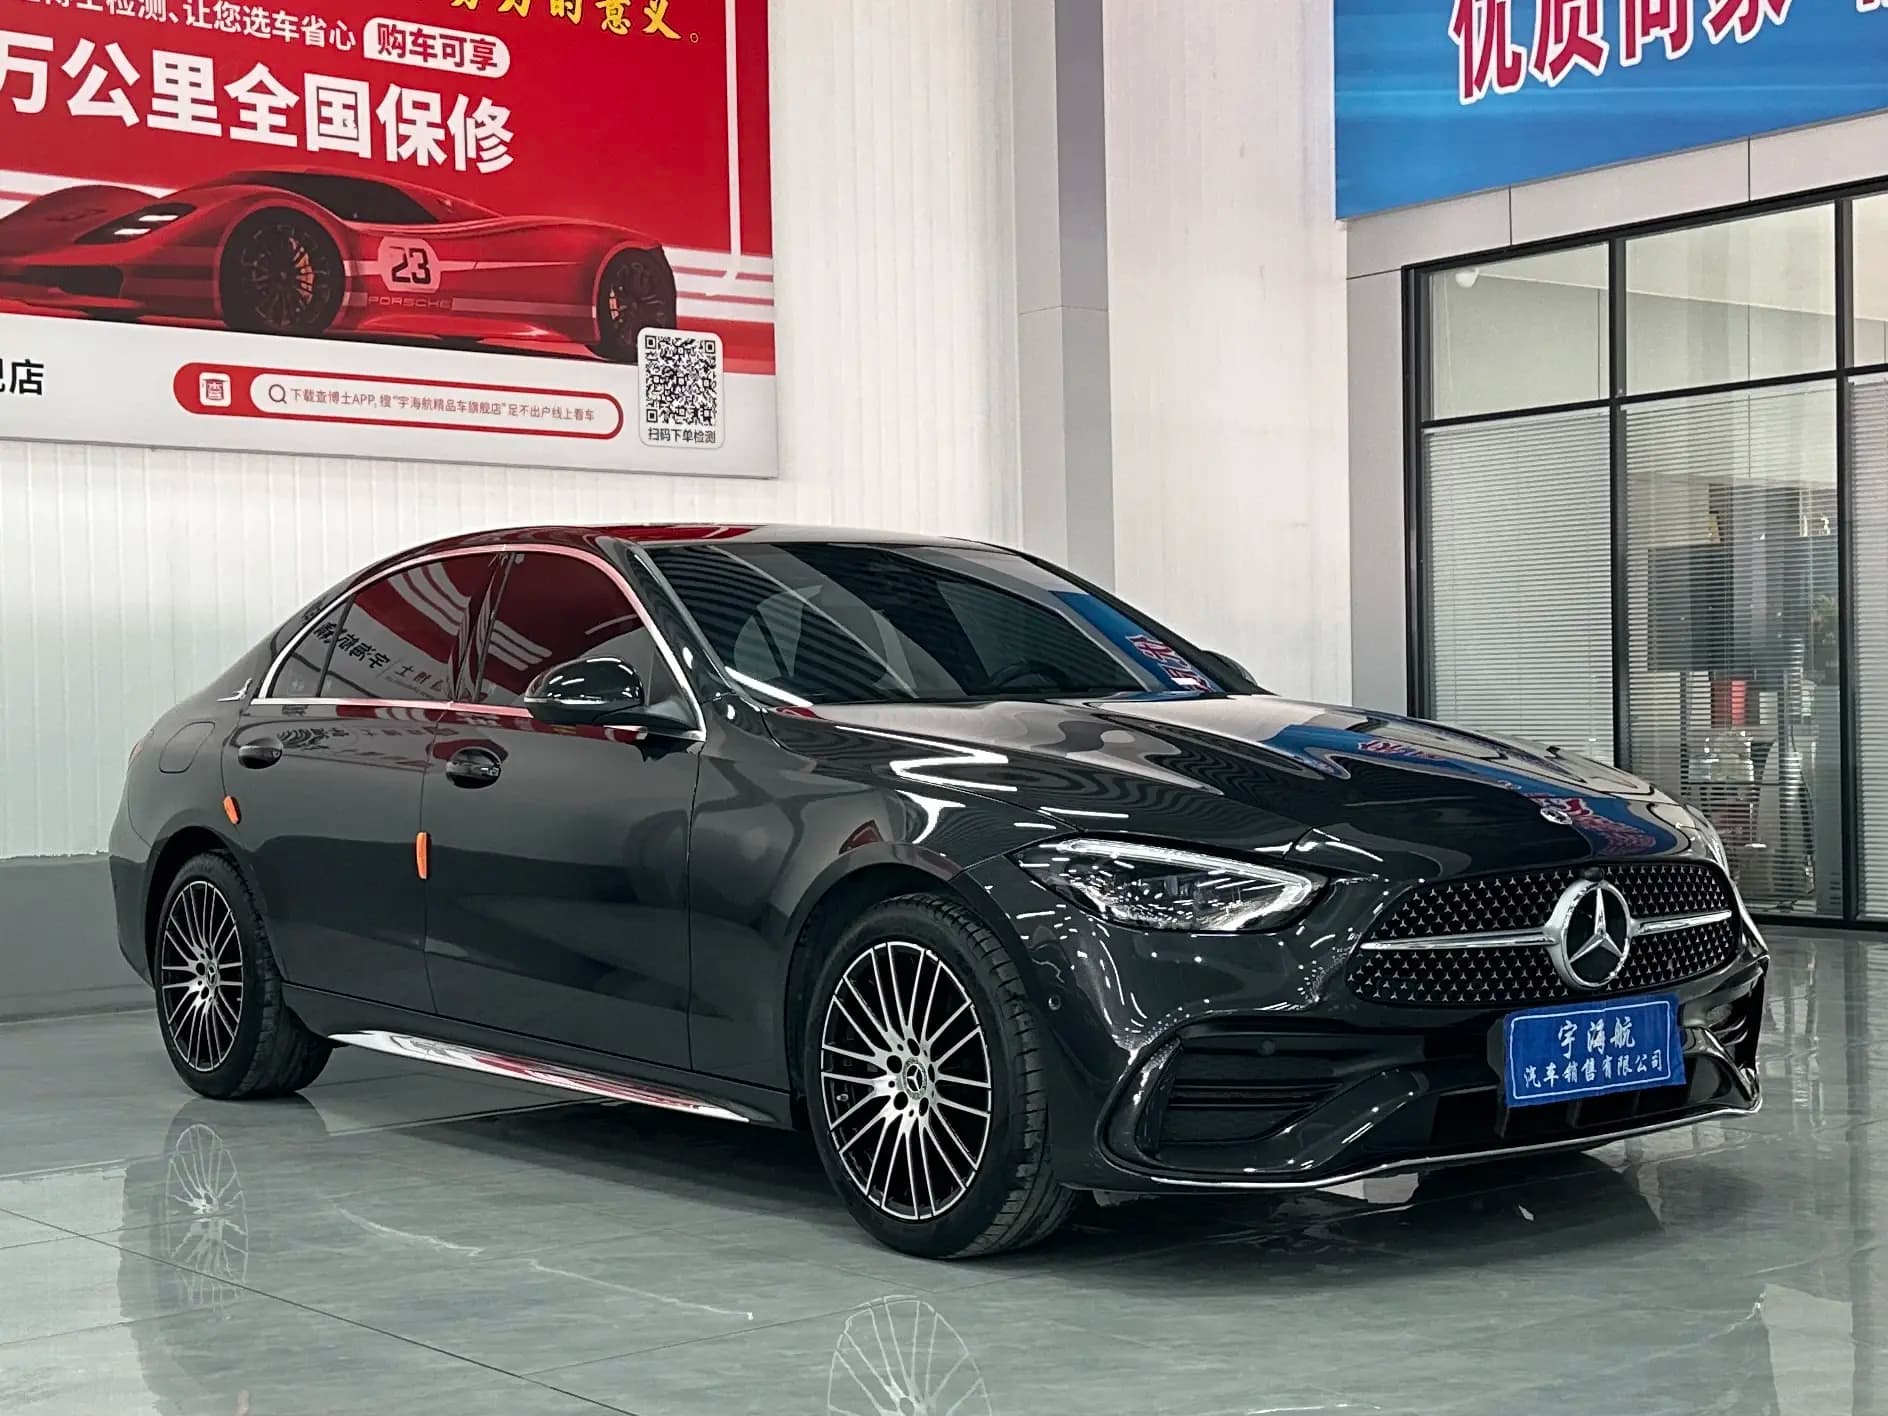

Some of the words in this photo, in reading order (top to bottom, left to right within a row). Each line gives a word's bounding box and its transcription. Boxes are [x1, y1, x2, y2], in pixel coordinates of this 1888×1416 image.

[27, 0, 356, 51] 检测、让您选车省心
[377, 22, 498, 72] 购车可享
[0, 30, 514, 174] 万公里全国保修
[389, 245, 431, 284] 23
[0, 358, 44, 396] 店
[648, 427, 716, 444] 扫码下单检测
[1558, 1016, 1636, 1060] 宇海航
[1523, 1049, 1663, 1089] 汽车销售有限公司
